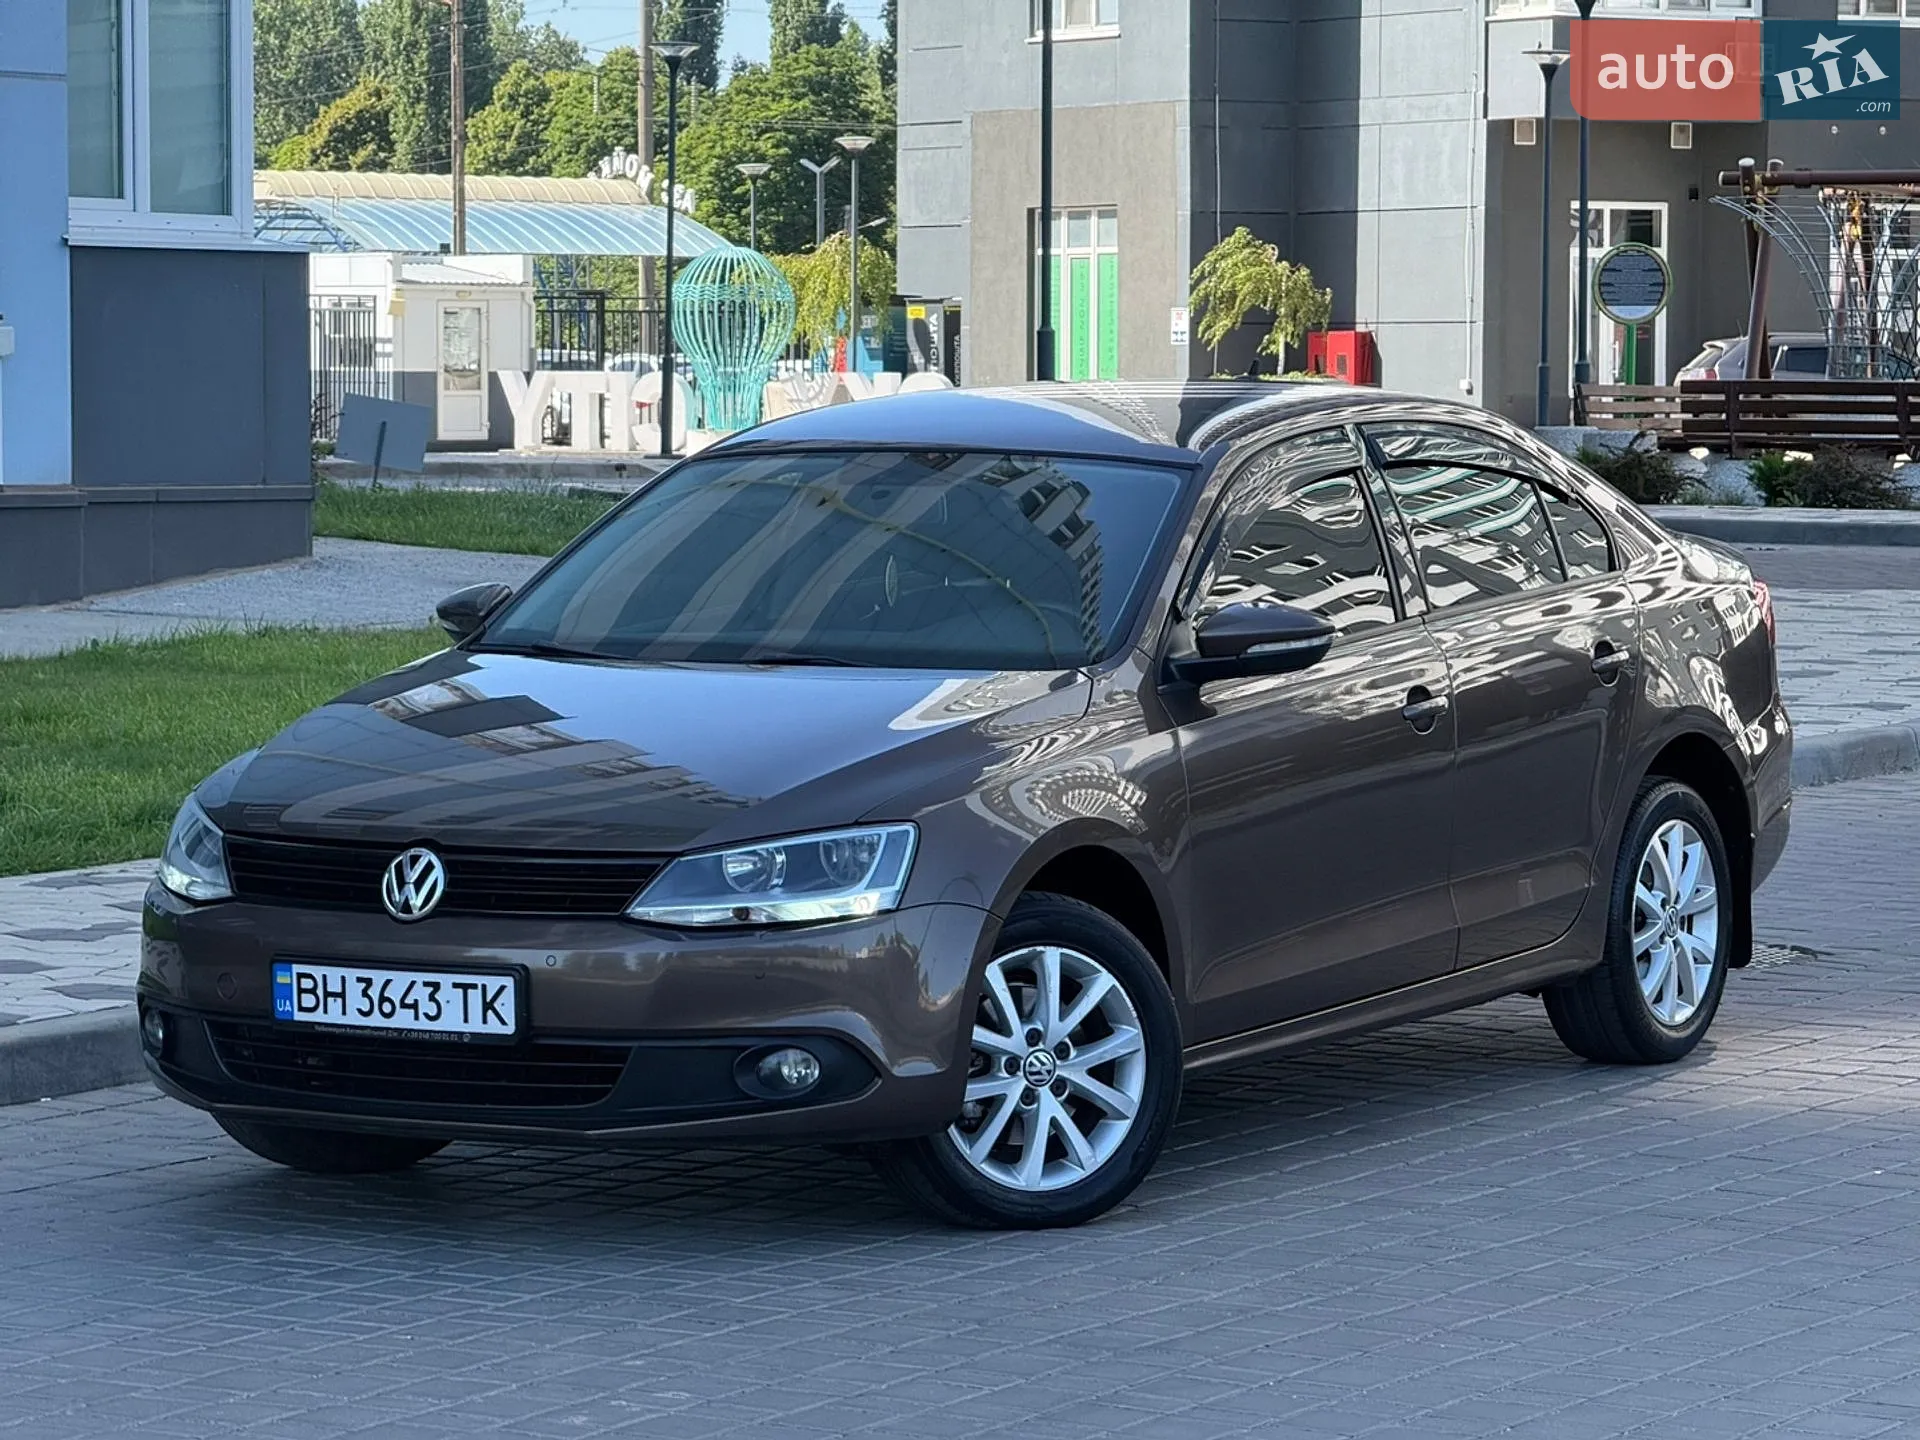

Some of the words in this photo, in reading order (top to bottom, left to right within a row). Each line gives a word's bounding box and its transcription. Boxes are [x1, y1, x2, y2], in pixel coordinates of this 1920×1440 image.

[928, 313, 939, 373] ПОШТА
[382, 846, 445, 921] VW
[276, 999, 292, 1013] UA
[296, 972, 347, 1016] BH
[355, 976, 443, 1022] 3643
[451, 982, 509, 1026] TK
